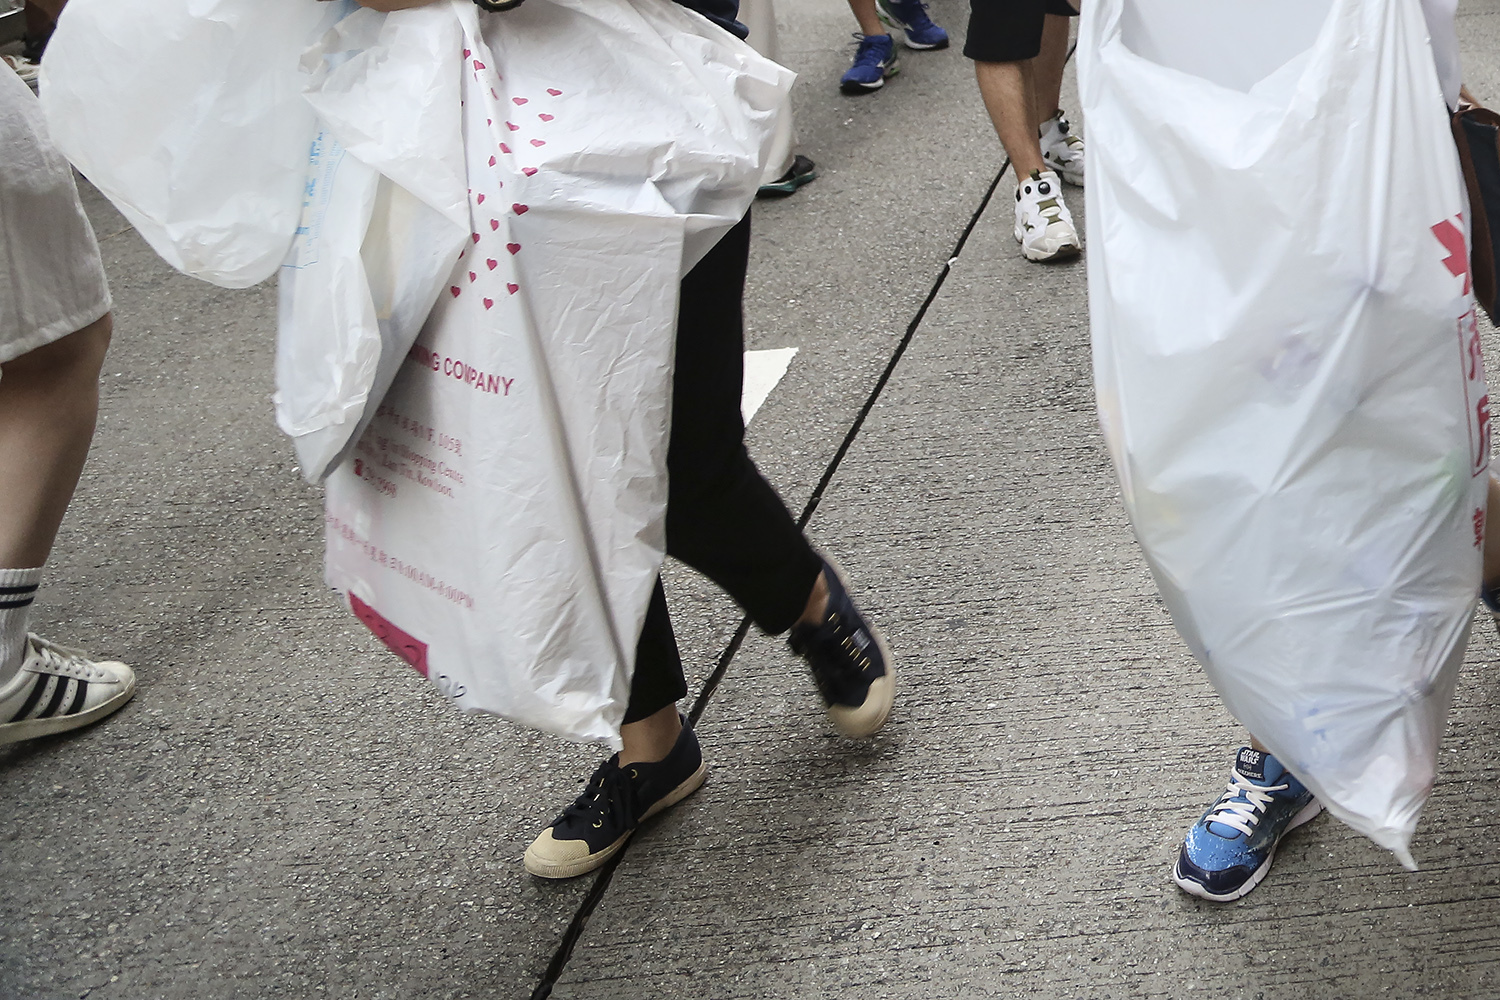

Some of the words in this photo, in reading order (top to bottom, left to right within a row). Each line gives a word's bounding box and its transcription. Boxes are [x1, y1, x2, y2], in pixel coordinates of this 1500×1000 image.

[443, 356, 515, 397] COMPANY
[1240, 754, 1260, 765] WARS
[1241, 749, 1260, 759] STAR
